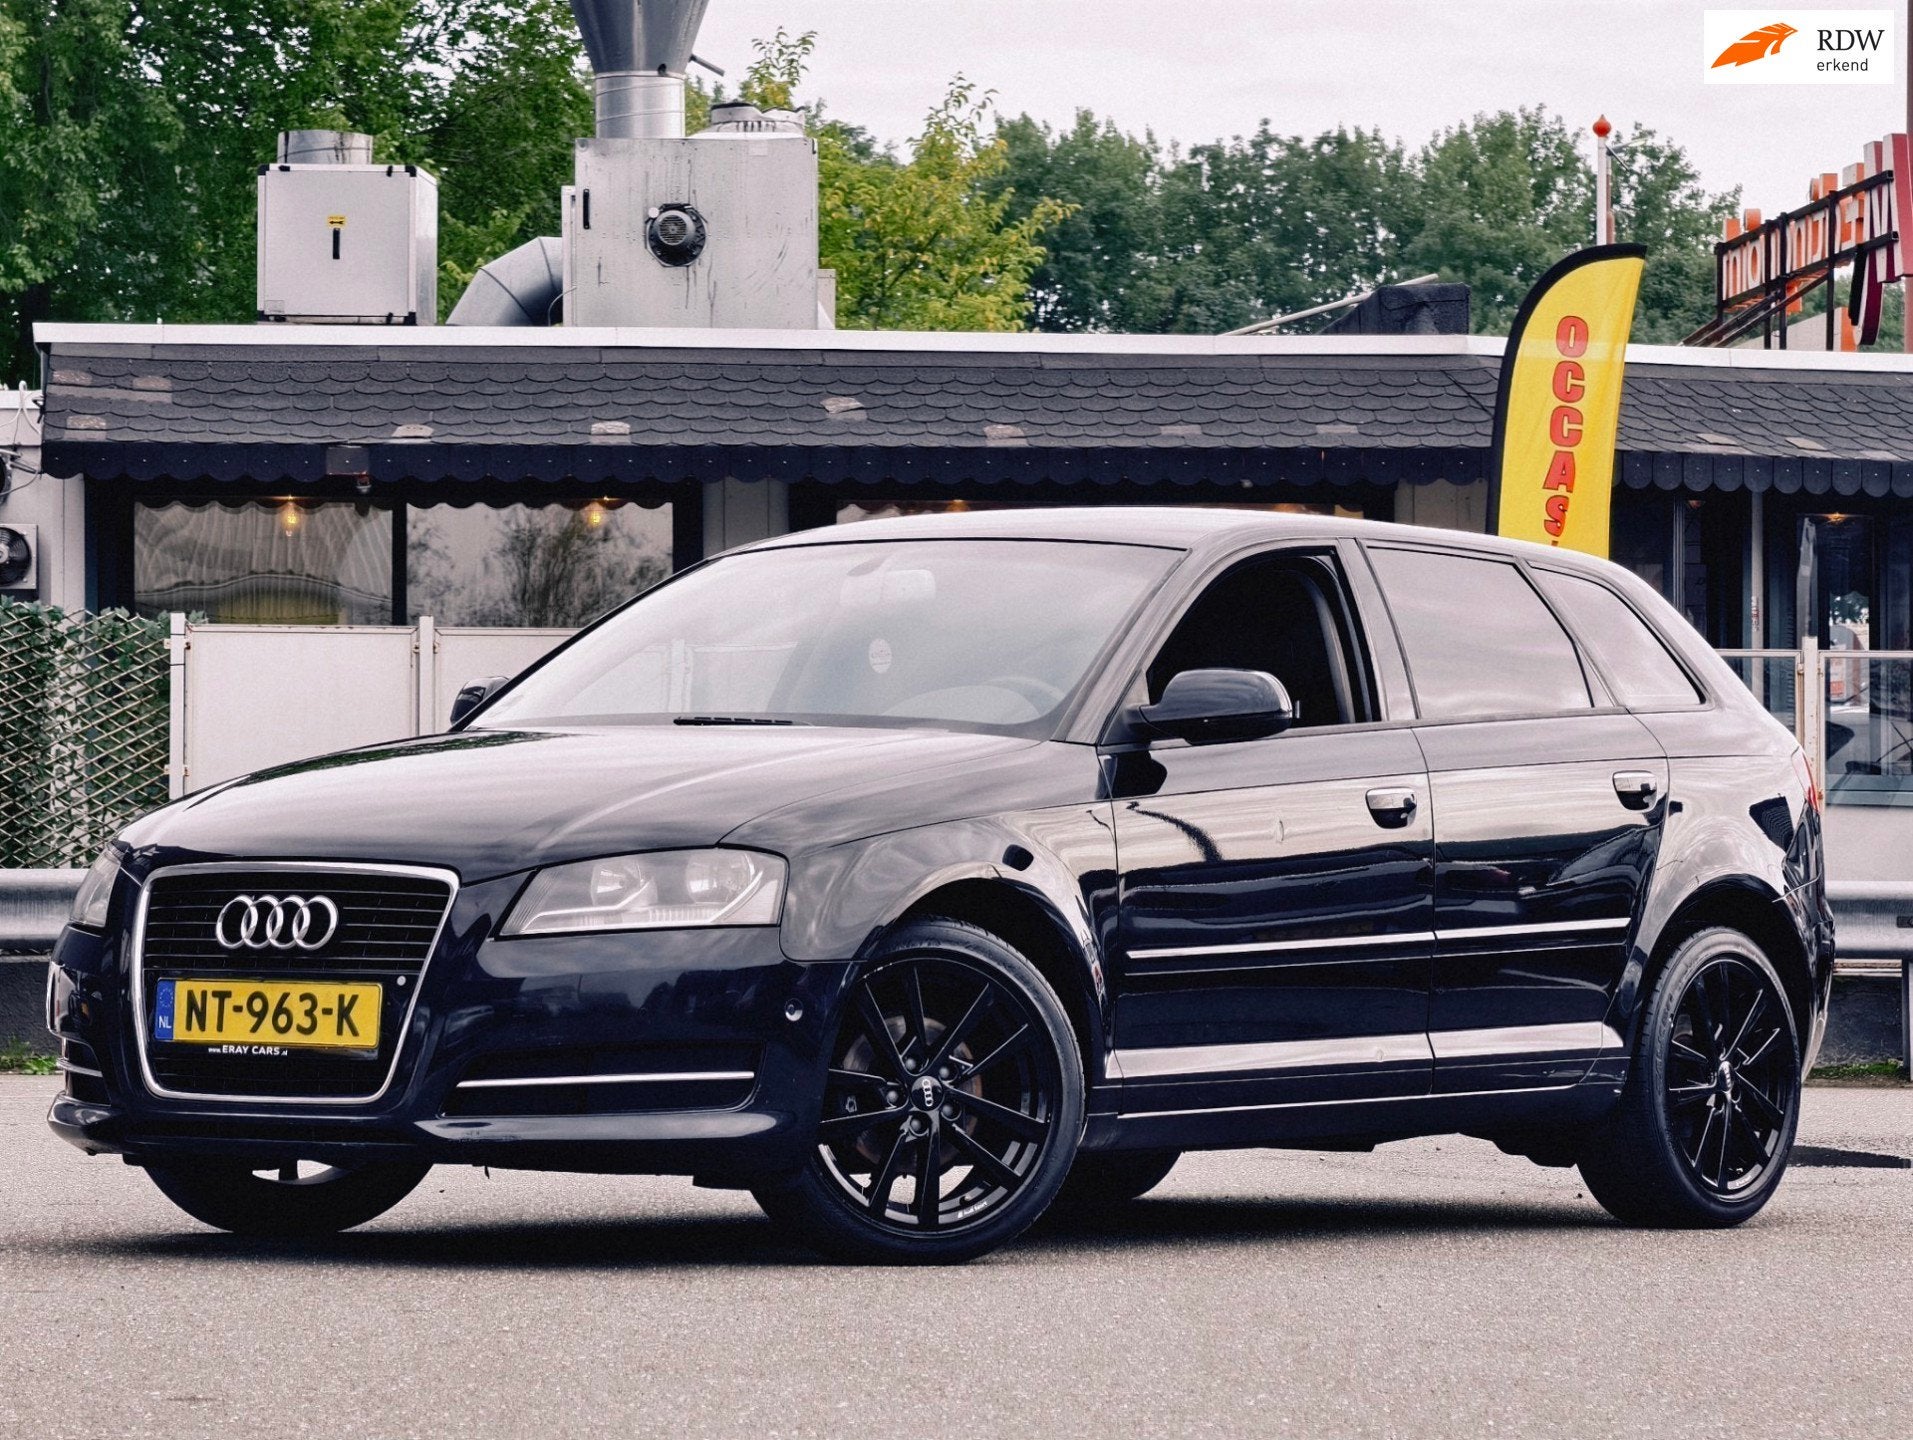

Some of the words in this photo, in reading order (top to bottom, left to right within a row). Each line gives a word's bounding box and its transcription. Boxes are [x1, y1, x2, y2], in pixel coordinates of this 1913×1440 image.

[1542, 315, 1589, 546] OCCAS
[158, 1015, 172, 1029] NL
[185, 989, 360, 1037] NT-963-K
